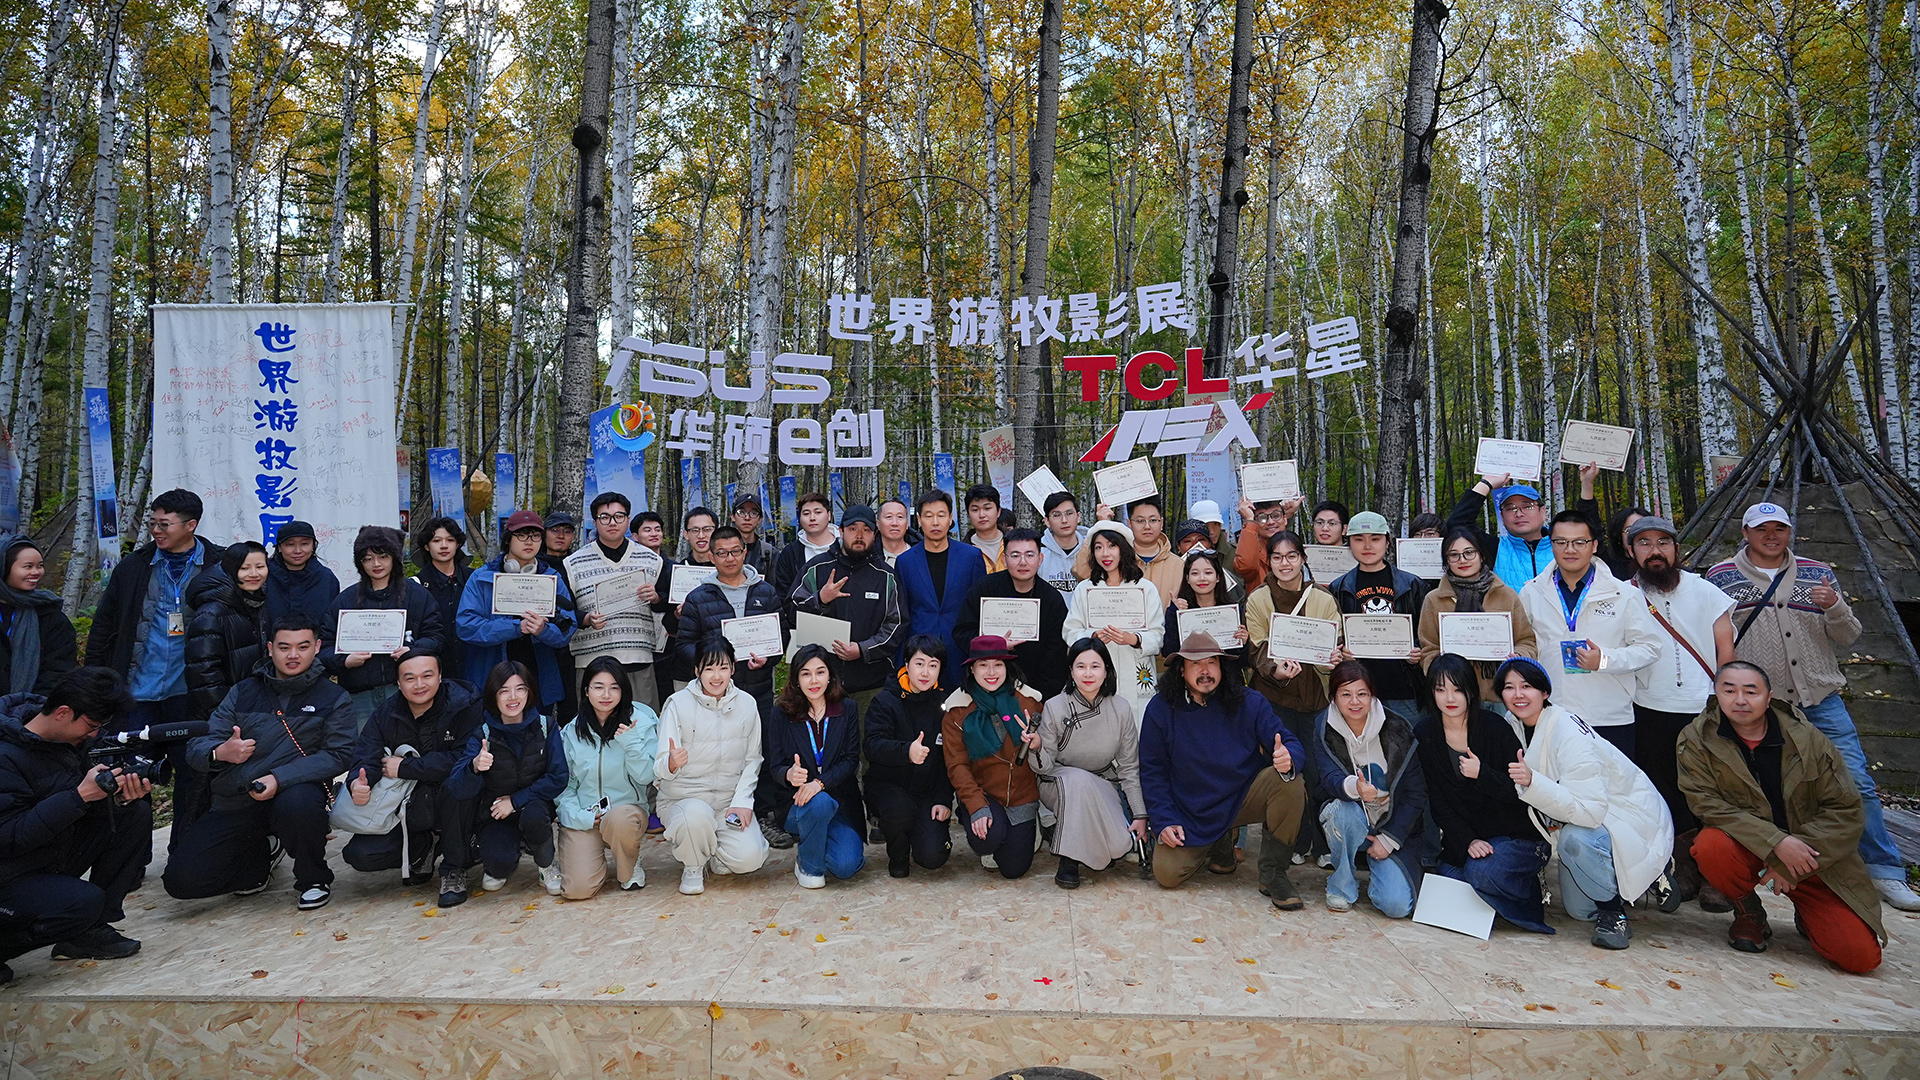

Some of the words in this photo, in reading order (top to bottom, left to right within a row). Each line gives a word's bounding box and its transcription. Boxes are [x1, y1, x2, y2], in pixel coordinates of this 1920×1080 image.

[828, 281, 1192, 346] 世界游牧影展
[605, 336, 833, 404] ASUS
[1063, 347, 1229, 402] TCL
[1235, 316, 1367, 388] 华星
[666, 408, 885, 467] 华硕e创
[166, 729, 189, 737] RØDE
